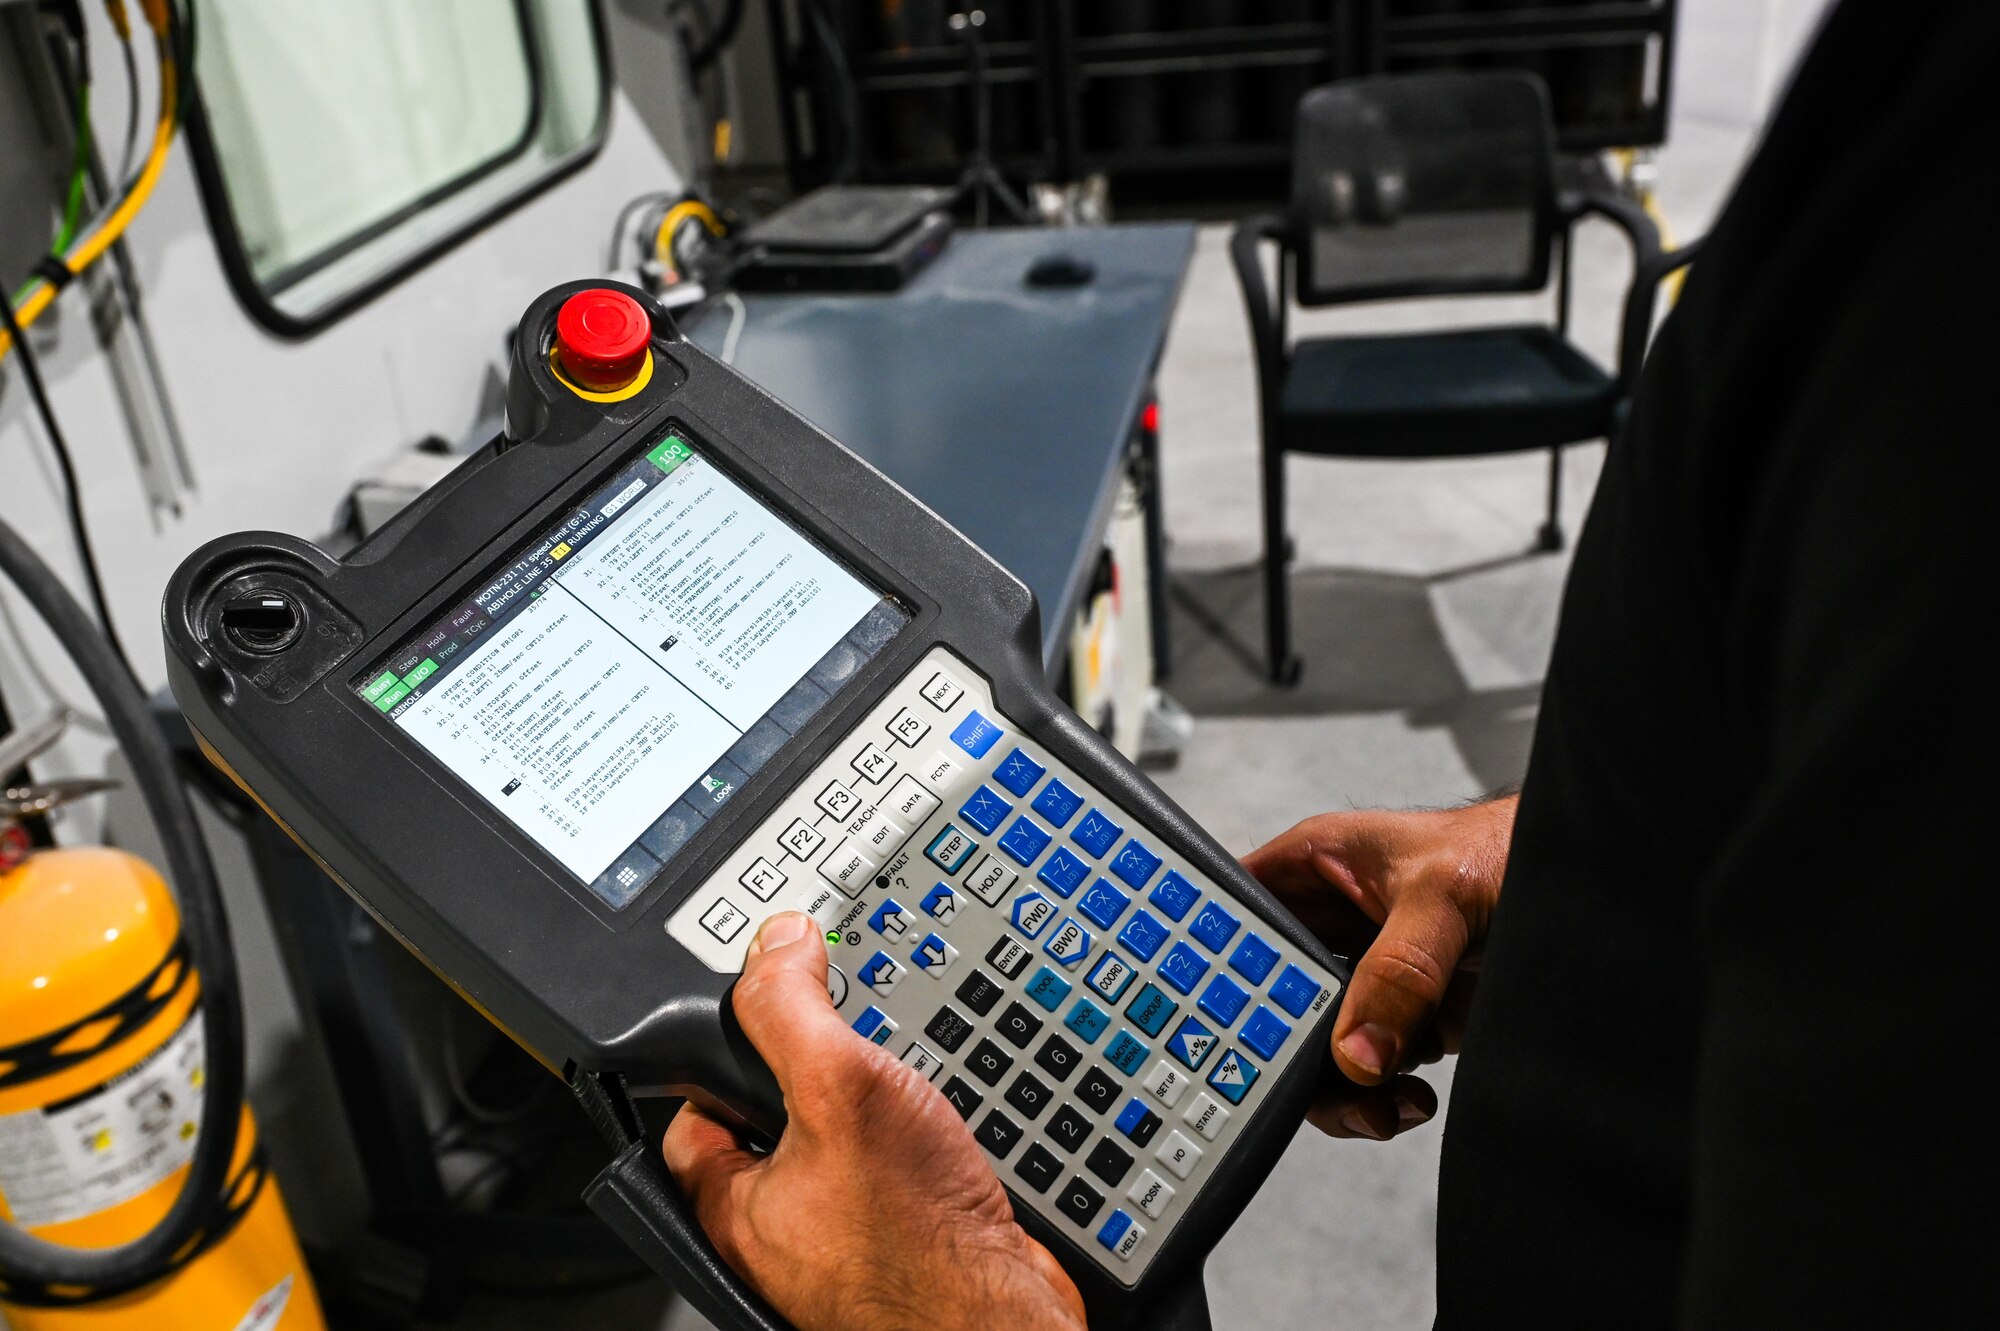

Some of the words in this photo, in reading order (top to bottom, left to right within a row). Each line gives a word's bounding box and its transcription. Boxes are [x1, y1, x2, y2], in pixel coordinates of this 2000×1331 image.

[659, 445, 681, 464] 100
[487, 582, 523, 614] ABIHOLE
[520, 566, 542, 584] LINE
[539, 555, 553, 569] 35
[552, 546, 567, 556] T1
[567, 514, 603, 545] RUNNING
[604, 502, 618, 514] G1
[616, 479, 646, 503] WORLD
[475, 570, 517, 605] MOTN-231
[514, 560, 529, 571] T1
[528, 540, 552, 562] speed
[549, 527, 569, 543] limit
[567, 510, 590, 529] (G:1)
[554, 554, 582, 579] ABIHOLE
[452, 609, 473, 626] Fault
[464, 619, 485, 635] TCyc
[426, 631, 445, 648] Hold
[438, 641, 457, 658] Prod
[398, 656, 418, 671] Step
[253, 660, 289, 688] OFF
[412, 667, 428, 680] I/O
[370, 679, 390, 695] Busy
[932, 682, 950, 701] NEXT
[384, 690, 401, 704] Run
[390, 690, 422, 720] ABIHOLE
[897, 717, 918, 736] F5
[963, 718, 993, 748] SHIFT
[863, 754, 883, 773] F4
[930, 761, 949, 781] FCTN
[1008, 757, 1024, 775] +X
[713, 783, 733, 802] LOOK
[827, 791, 848, 810] F3
[1046, 787, 1061, 806] +Y
[901, 793, 921, 813] DATA
[975, 794, 991, 813] -X
[846, 804, 877, 834] TEACH
[1085, 817, 1102, 837] +Z
[790, 829, 813, 849] F2
[872, 825, 889, 844] EDIT
[1014, 825, 1028, 844] -Y
[939, 836, 960, 861] STEP
[838, 856, 861, 880] SELECT
[885, 852, 909, 878] FAULT
[1053, 856, 1069, 875] -Z
[1127, 852, 1142, 868] +X
[751, 869, 773, 889] F1
[977, 867, 1002, 894] HOLD
[1166, 883, 1179, 899] +Y
[807, 891, 830, 914] MENU
[713, 908, 734, 931] PREV
[835, 900, 867, 933] POWER
[1022, 902, 1047, 929] FWD
[1206, 914, 1221, 930] +Z
[1052, 926, 1077, 954] BWD
[998, 943, 1022, 969] ENTER
[1033, 975, 1054, 994] TOOL
[1099, 963, 1122, 990] COORD
[970, 982, 989, 1002] ITEM
[1312, 989, 1330, 1012] MHE2
[1073, 1007, 1093, 1026] TOOL
[1139, 995, 1161, 1024] GROUP
[856, 1013, 874, 1035] DISP
[934, 1013, 955, 1037] BACK
[942, 1019, 965, 1045] SPACE
[1011, 1017, 1026, 1031] 9
[1087, 1018, 1096, 1028] 2
[1111, 1037, 1132, 1061] MOVE
[1186, 1035, 1207, 1056] +%
[912, 1054, 928, 1071] SET
[981, 1054, 996, 1068] 8
[1051, 1049, 1066, 1063] 6
[1120, 1043, 1140, 1068] MENU
[1221, 1062, 1239, 1084] -%
[1091, 1082, 1106, 1097] 3
[1156, 1081, 1169, 1097] SET
[1164, 1071, 1176, 1084] UP
[948, 1091, 963, 1106] 7
[1021, 1086, 1036, 1102] 5
[1195, 1104, 1216, 1131] STATUS
[993, 1126, 1006, 1139] 4
[1061, 1120, 1077, 1136] 2
[1172, 1147, 1186, 1163] I/O
[1032, 1159, 1047, 1173] 1
[1073, 1194, 1088, 1208] 0
[1140, 1182, 1161, 1208] POSN
[1104, 1218, 1123, 1240] DIAG
[1119, 1230, 1137, 1254] HELP
